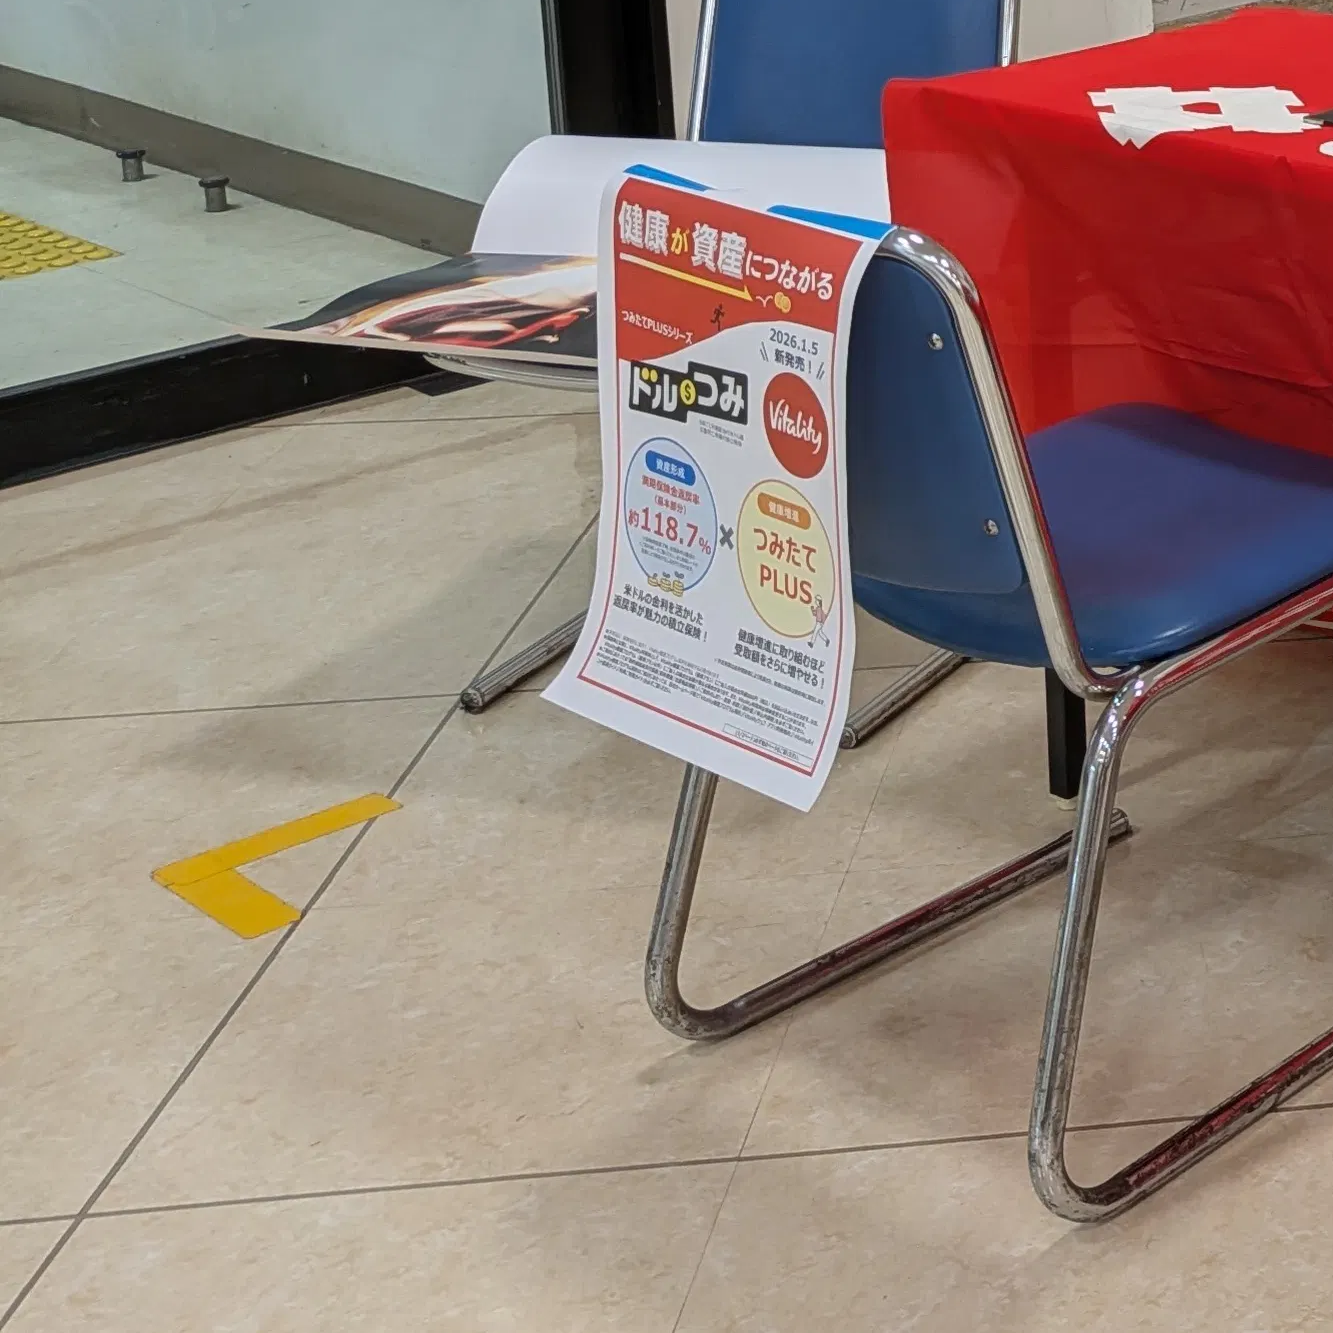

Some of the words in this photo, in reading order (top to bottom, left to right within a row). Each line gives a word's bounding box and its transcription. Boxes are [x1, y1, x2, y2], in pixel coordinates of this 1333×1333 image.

[618, 201, 833, 300] 健康が資産につながる
[621, 310, 694, 345] つみたてPLUSシリーズ
[769, 328, 819, 356] 2026.1.5
[769, 399, 823, 455] Vitality
[753, 527, 818, 573] つみたて
[623, 583, 704, 626] 米ドルの金利を活かした
[760, 564, 813, 605] PLUS
[738, 628, 825, 674] 健康増進に取り組むほど
